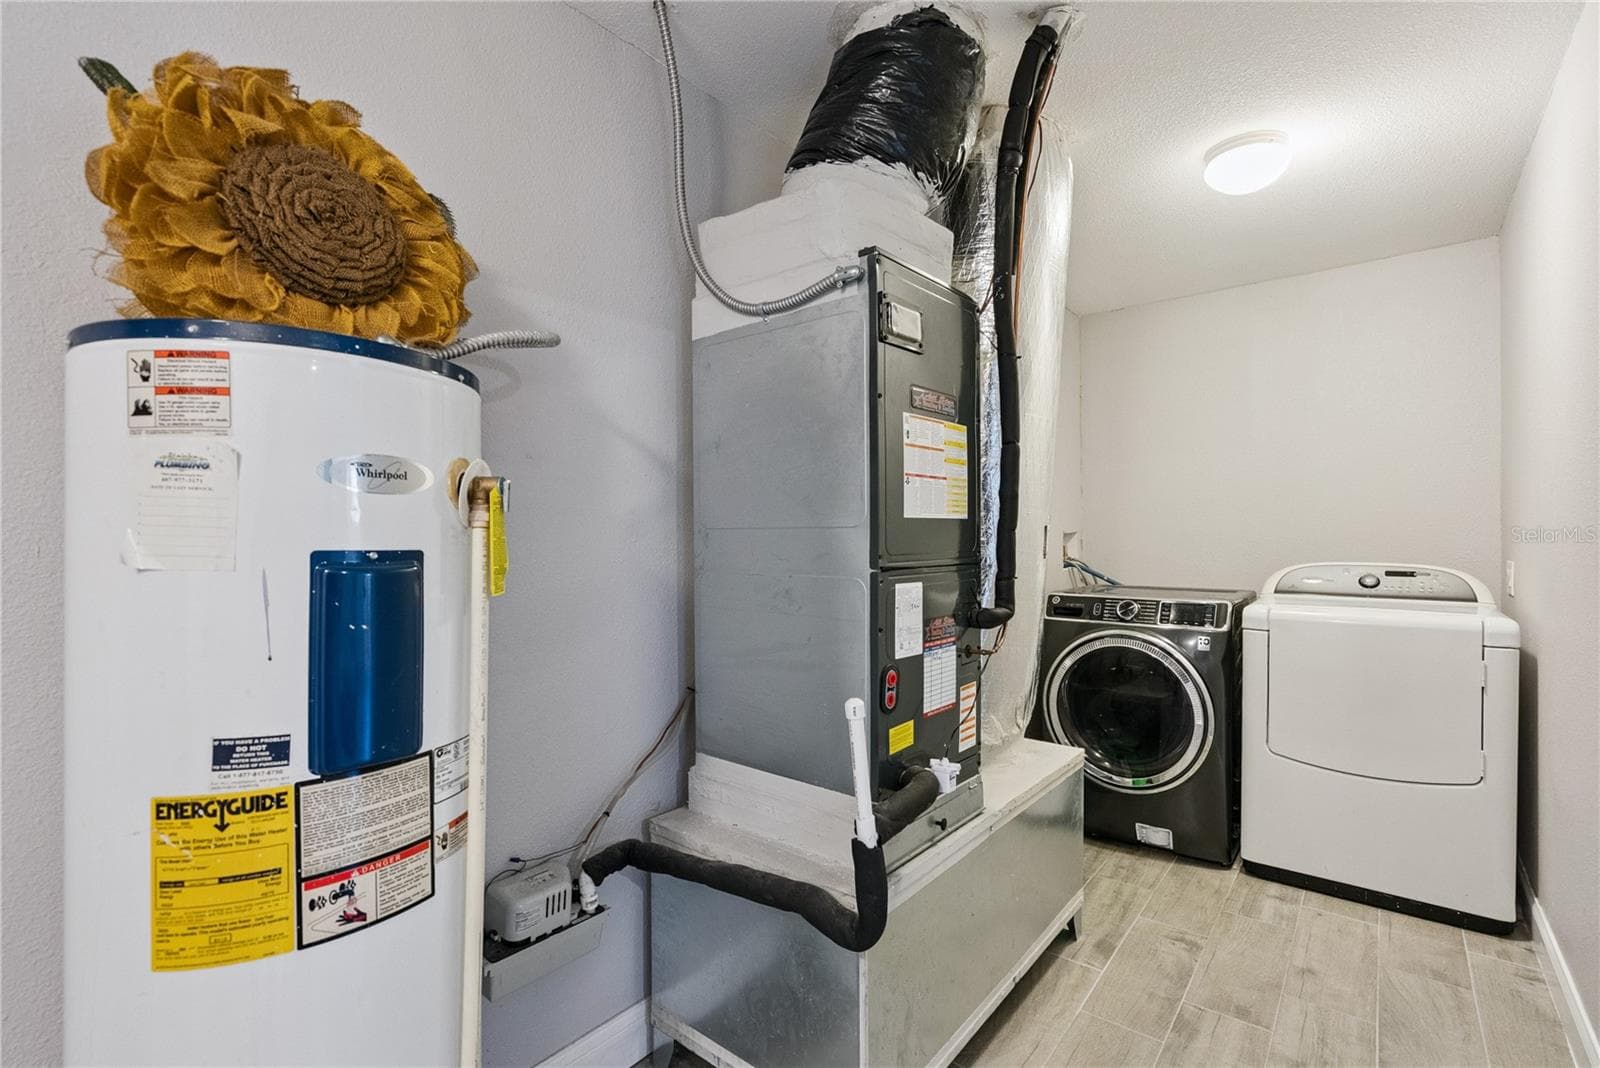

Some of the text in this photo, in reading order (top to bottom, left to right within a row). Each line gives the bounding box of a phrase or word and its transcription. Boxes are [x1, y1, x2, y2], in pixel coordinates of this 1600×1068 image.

[176, 387, 217, 395] WARNING
[356, 467, 408, 481] Whirlpool
[156, 792, 288, 820] ENERGYGUIDE
[362, 854, 401, 872] DANGER
